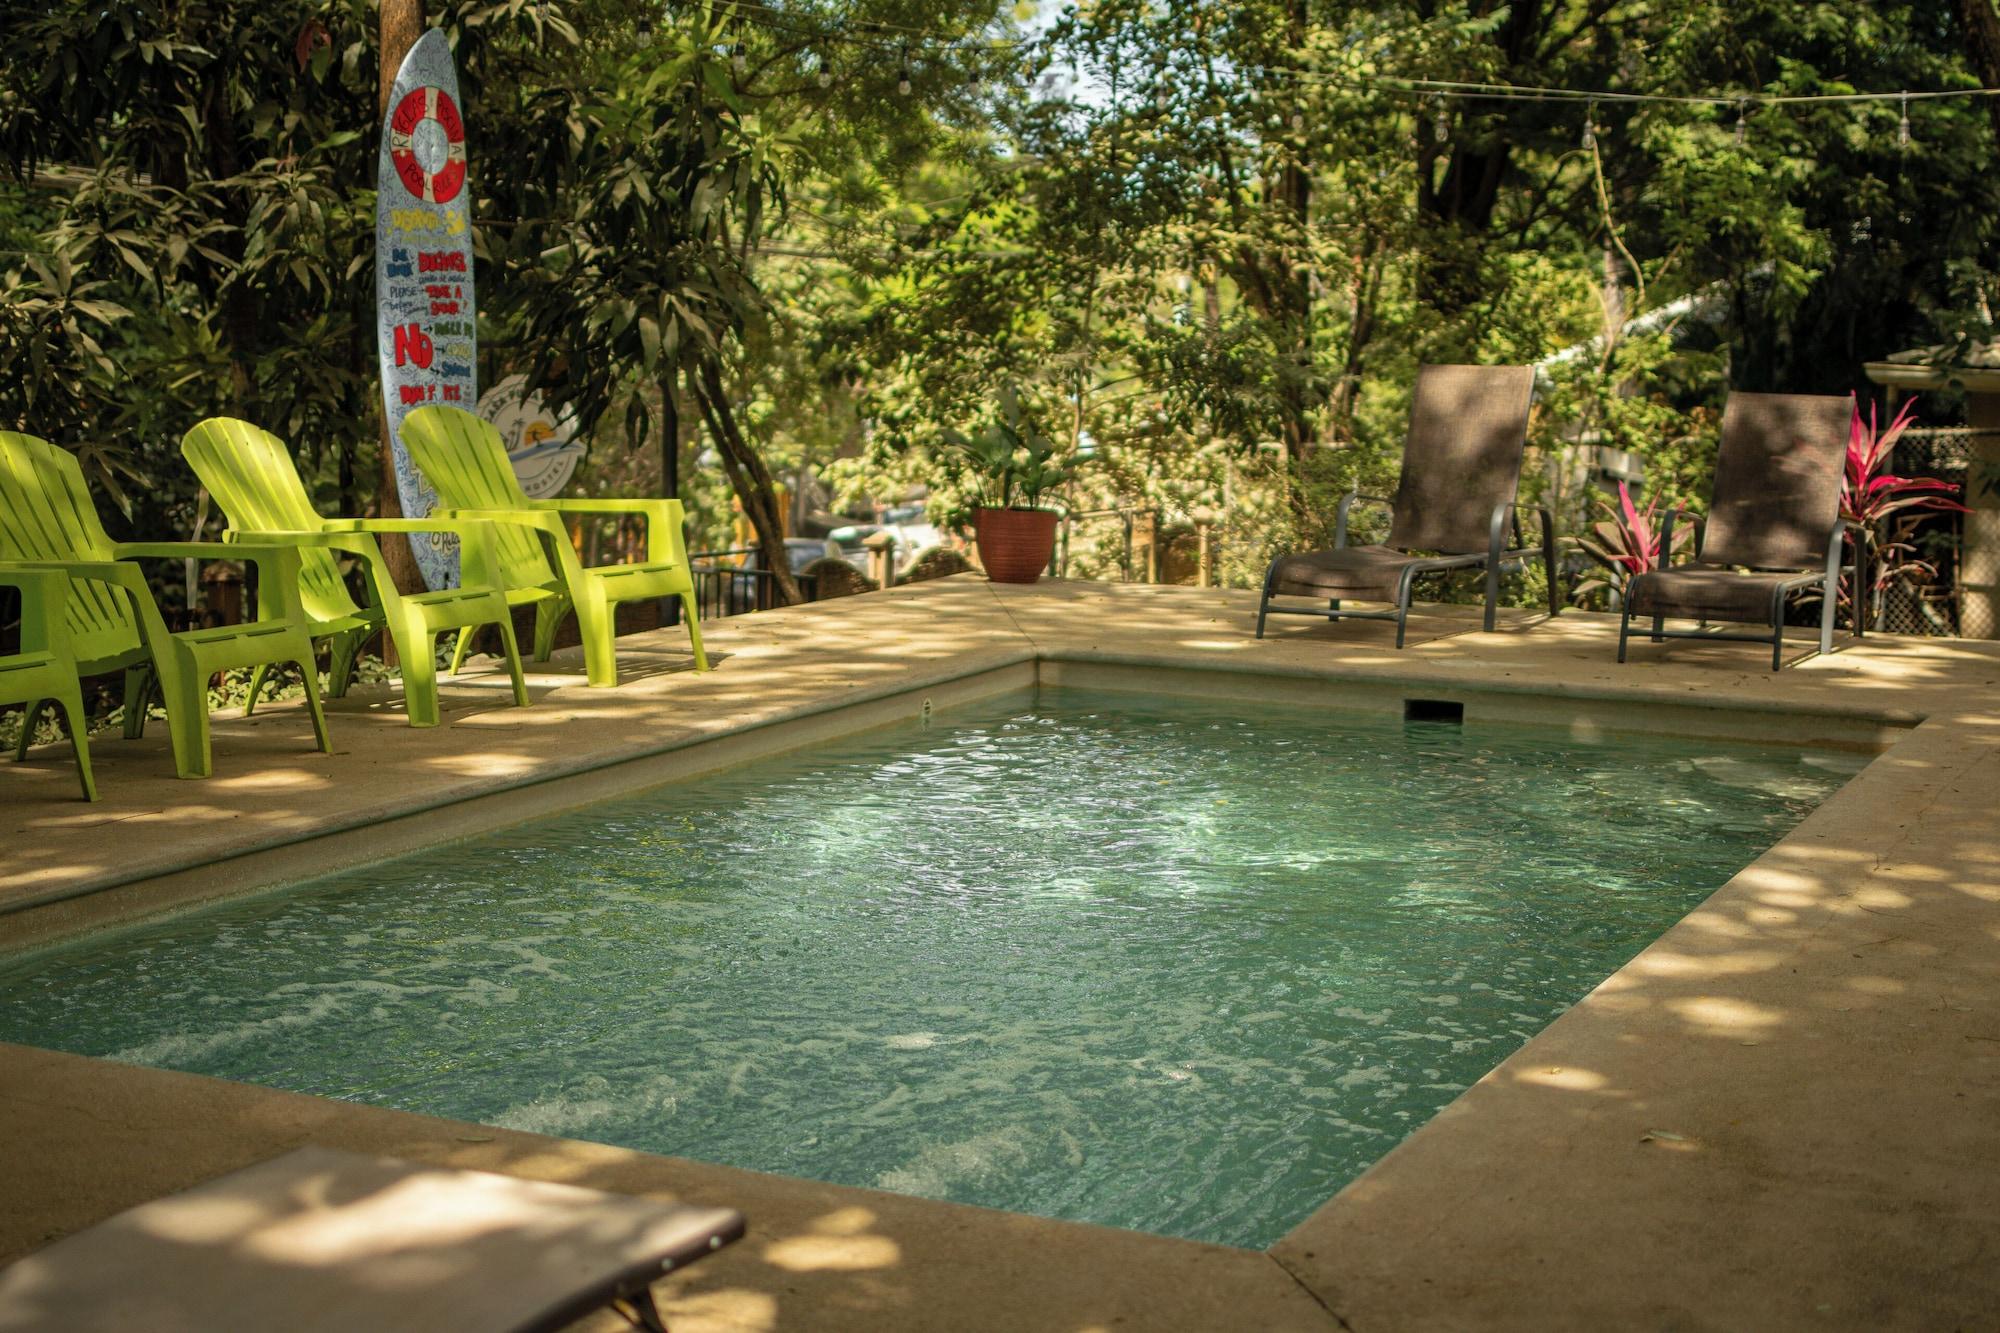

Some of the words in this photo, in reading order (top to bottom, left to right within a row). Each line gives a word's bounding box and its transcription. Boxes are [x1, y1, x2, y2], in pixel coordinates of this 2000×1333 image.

[404, 163, 431, 191] POOL
[390, 286, 417, 298] PLEASE
[524, 460, 564, 491] HOSTEL
